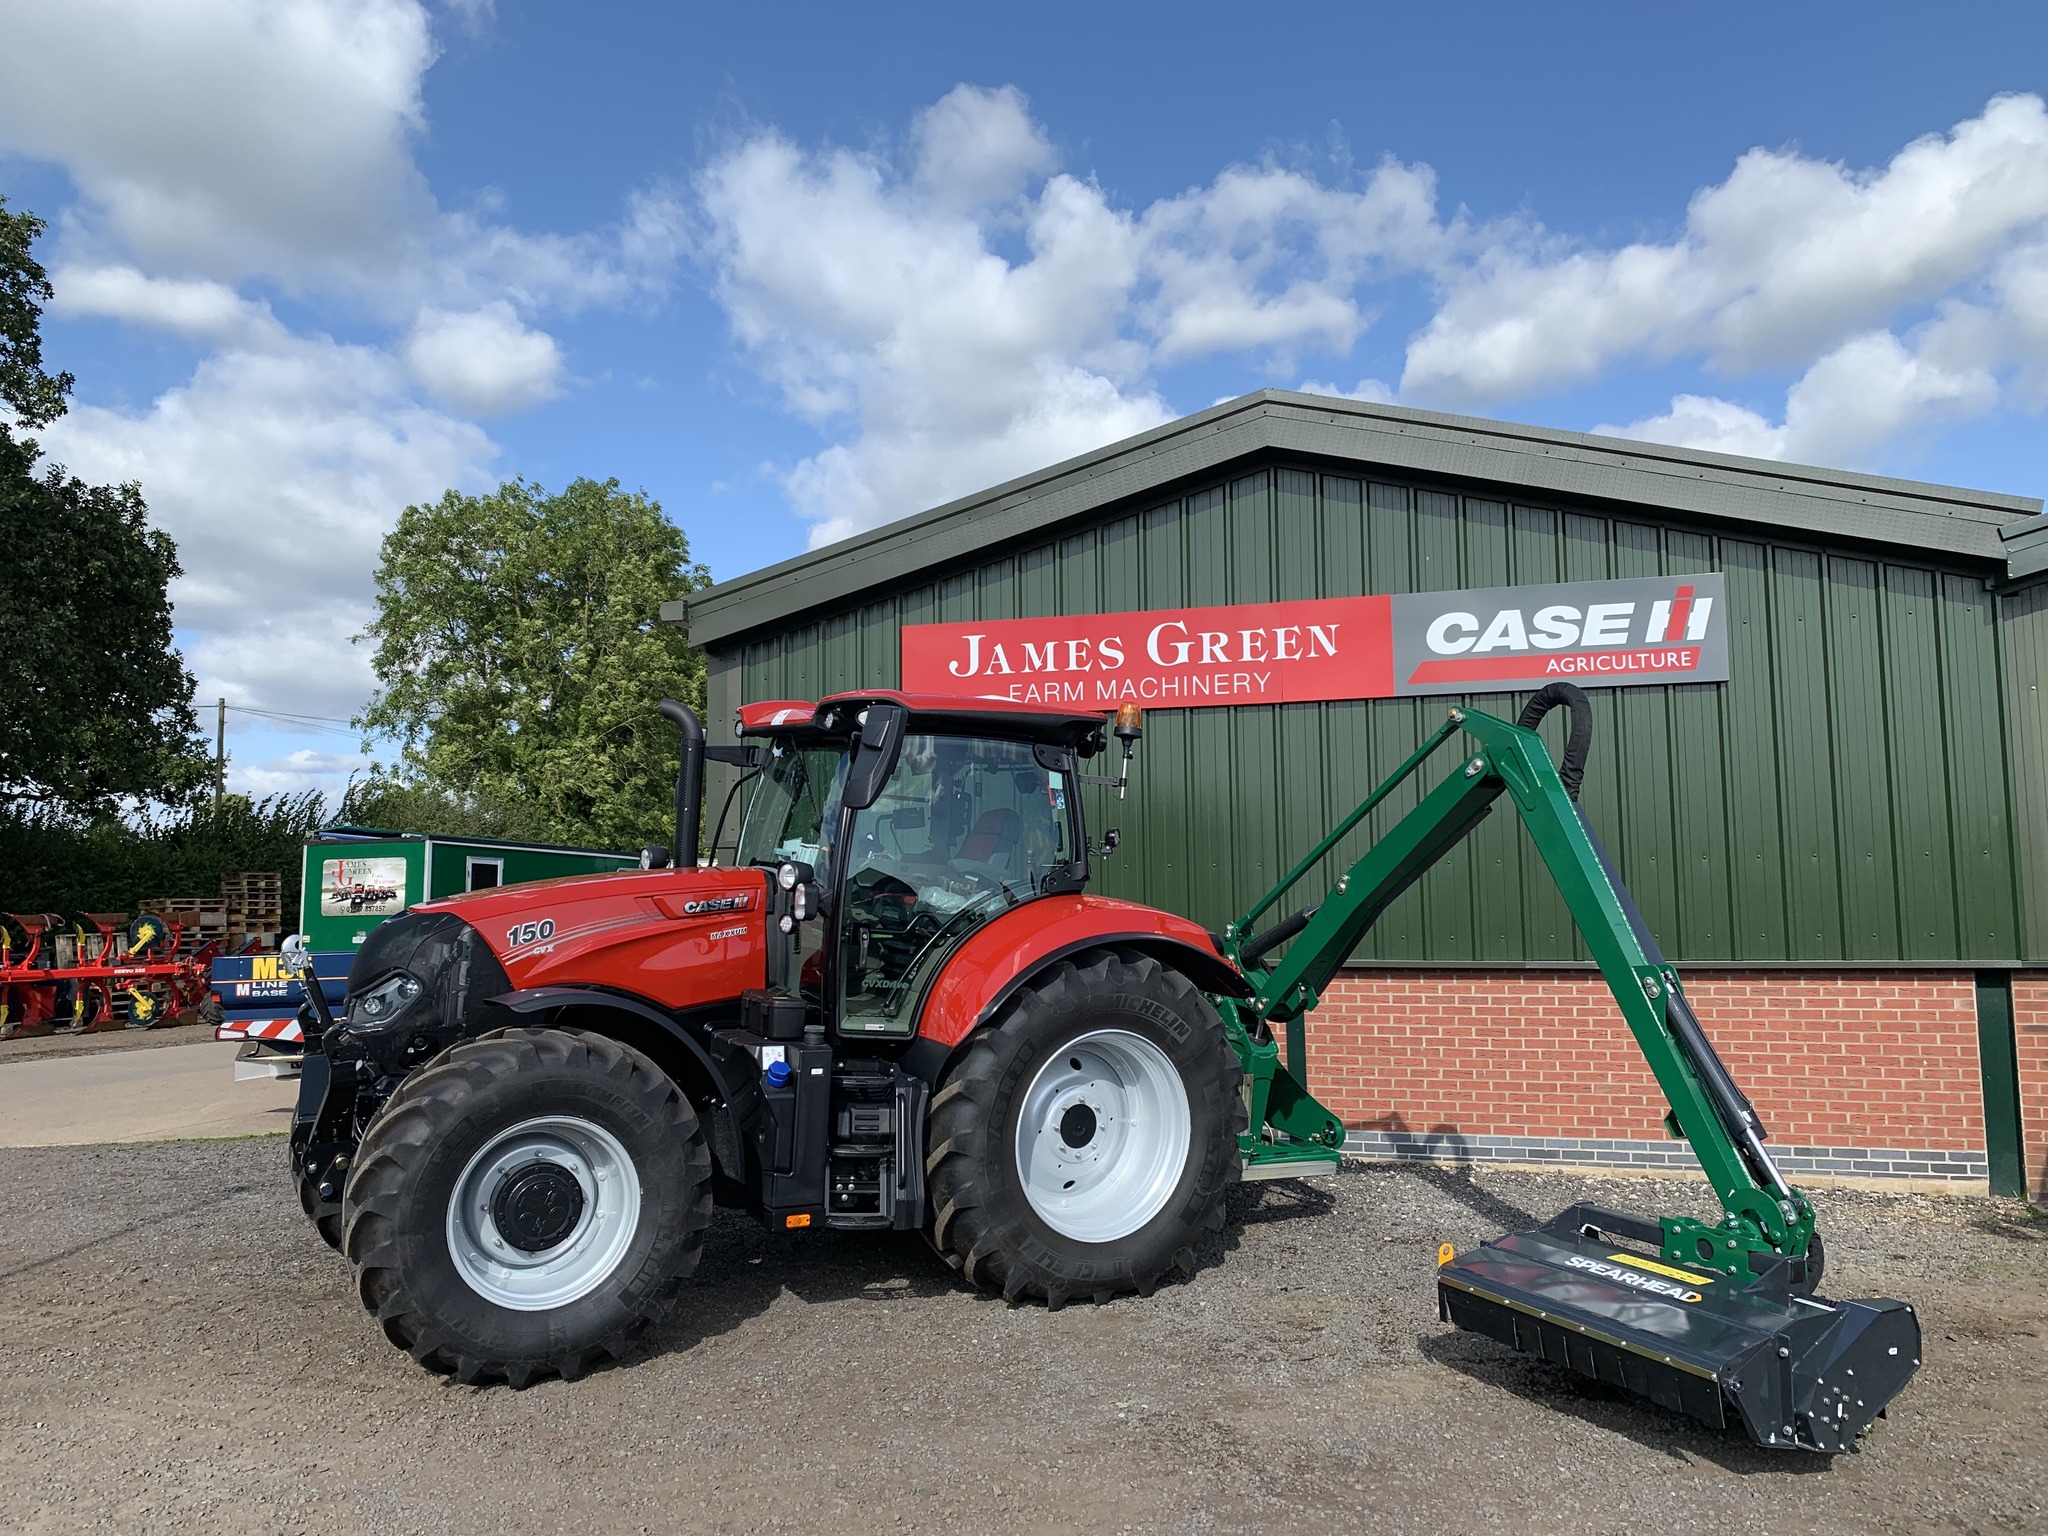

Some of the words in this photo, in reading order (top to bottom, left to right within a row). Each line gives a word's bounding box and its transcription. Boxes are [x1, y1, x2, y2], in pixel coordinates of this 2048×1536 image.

[1426, 602, 1636, 655] CASE
[948, 634, 1126, 678] JAMES
[1147, 619, 1341, 667] GREEN
[1545, 651, 1692, 674] AGRICULTURE
[1009, 680, 1085, 703] FARM
[1096, 671, 1272, 700] MACHINERY
[684, 897, 733, 914] CASE
[506, 918, 555, 948] 150
[710, 926, 748, 941] MAXXUM
[533, 943, 555, 955] CVX
[236, 983, 250, 996] M
[252, 981, 288, 989] LINE
[252, 989, 288, 997] BASE
[1564, 1256, 1702, 1303] SPEARHEAD
